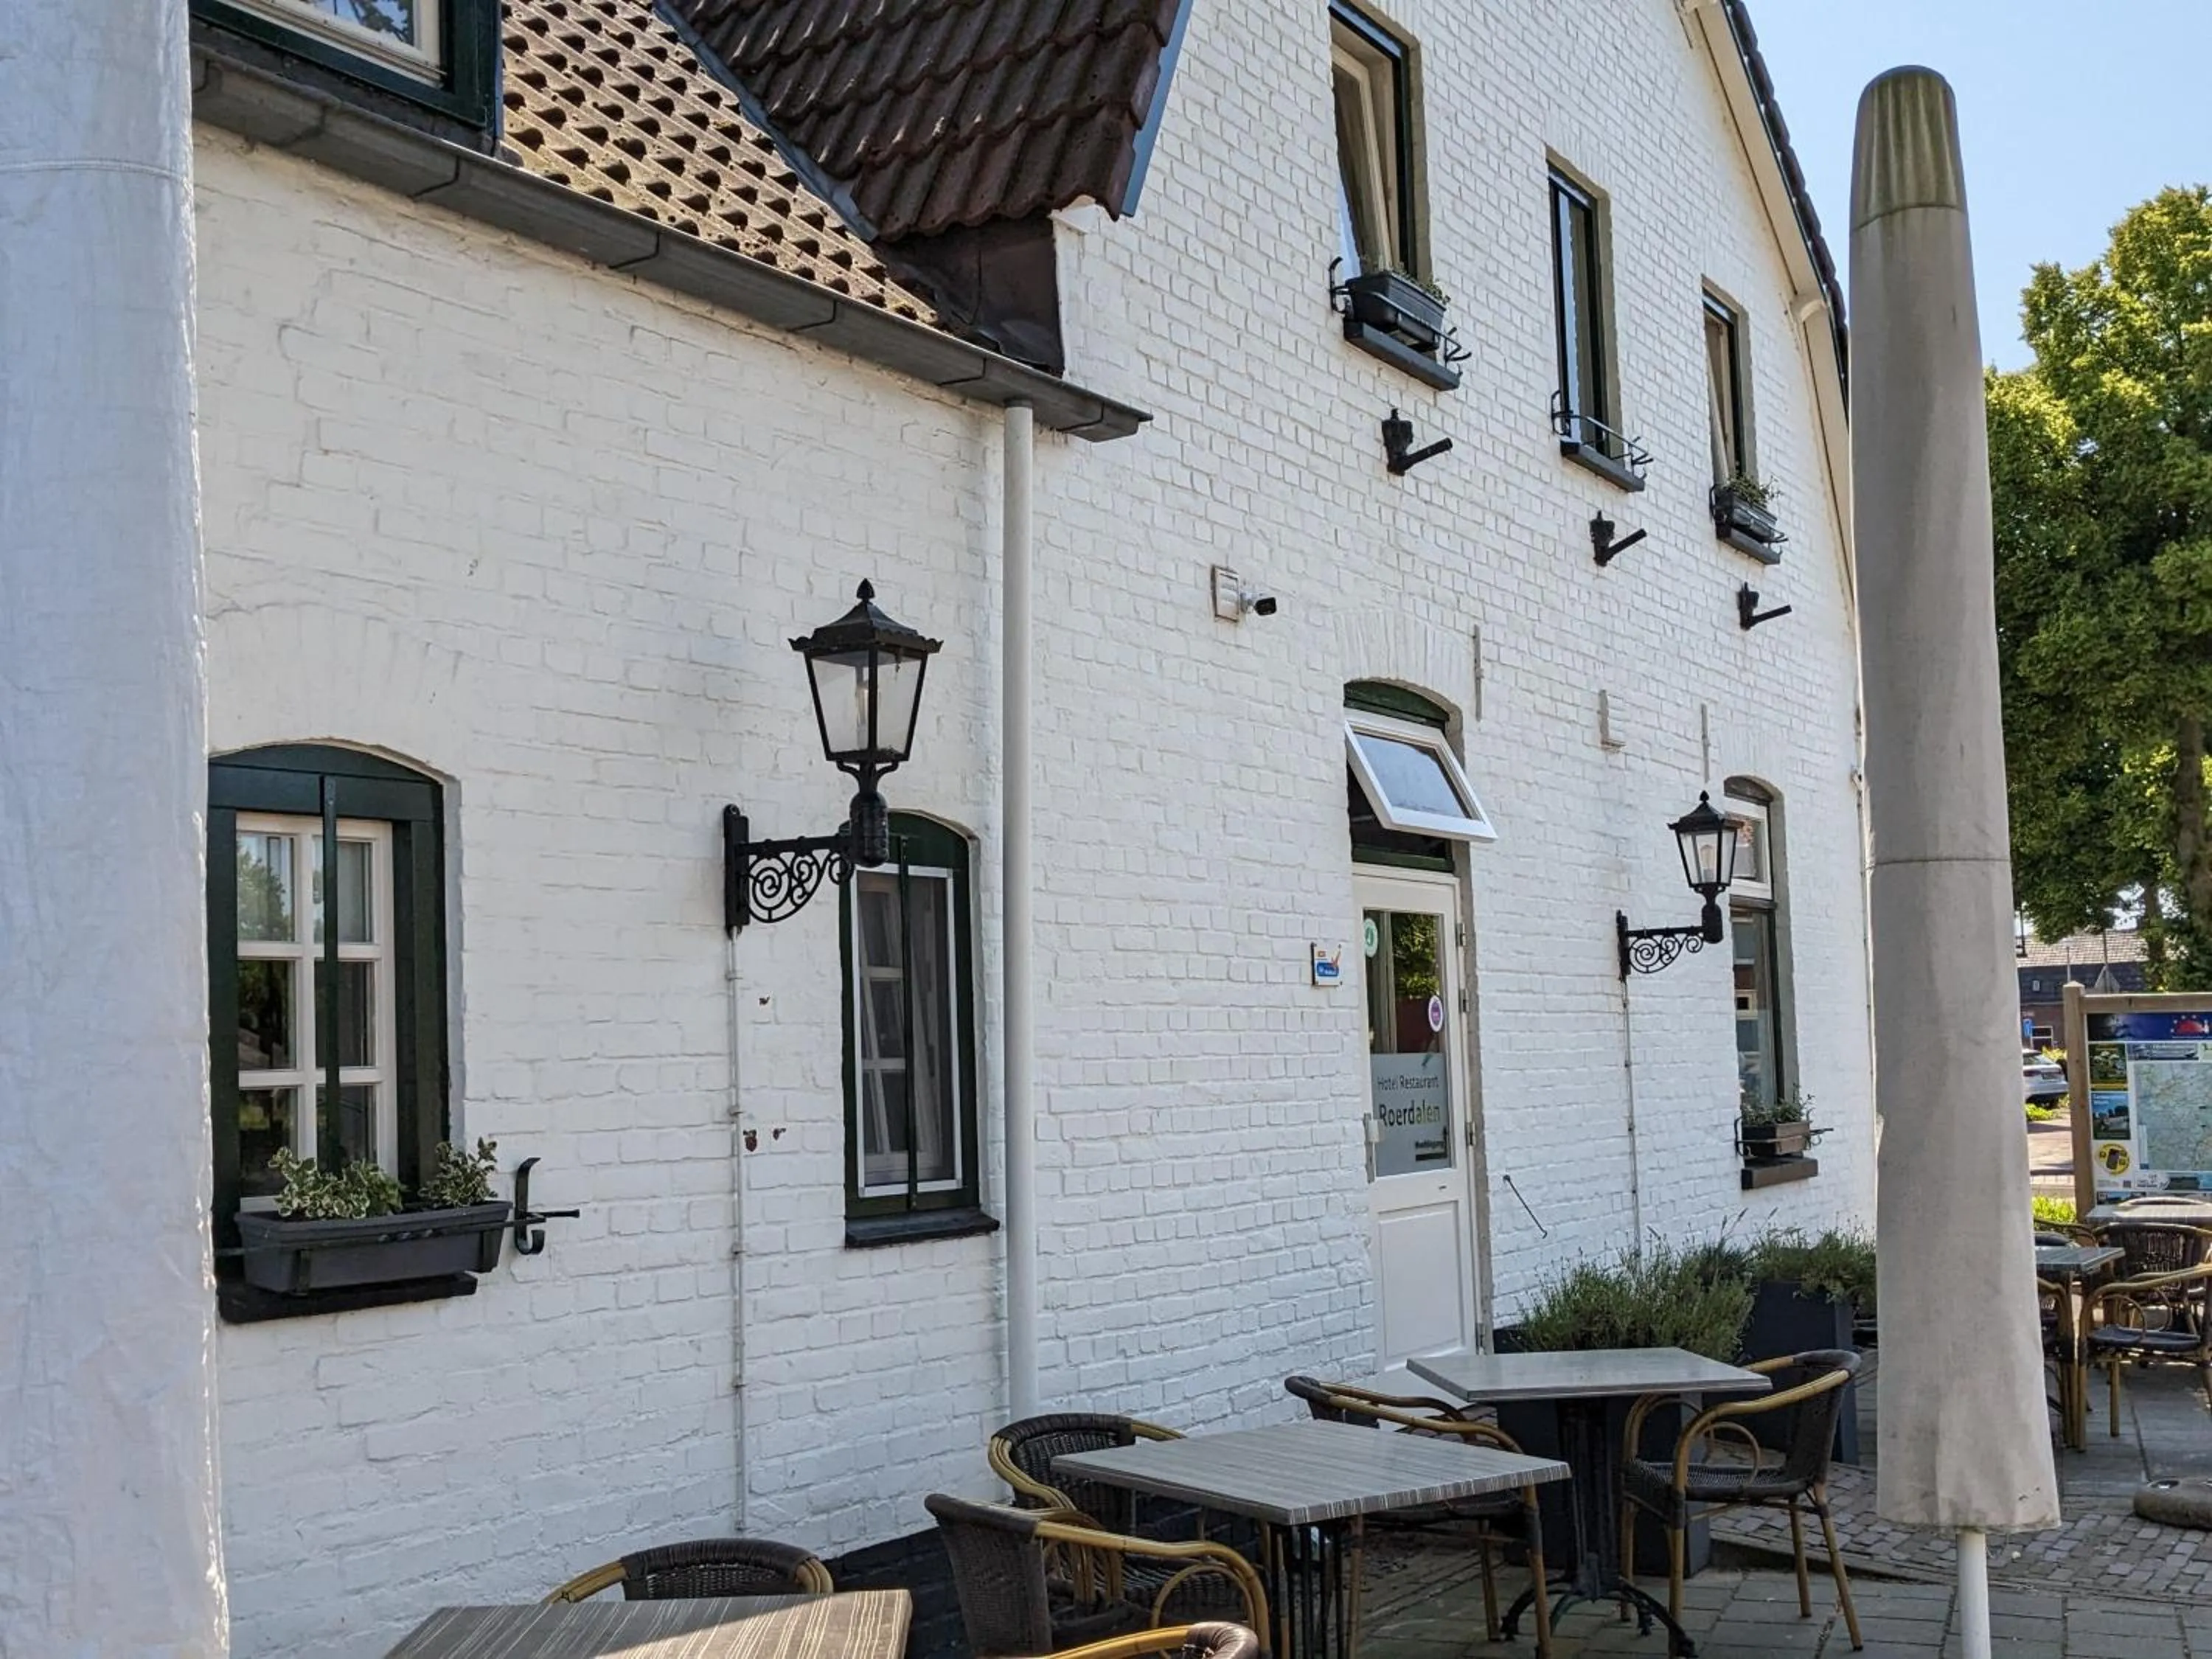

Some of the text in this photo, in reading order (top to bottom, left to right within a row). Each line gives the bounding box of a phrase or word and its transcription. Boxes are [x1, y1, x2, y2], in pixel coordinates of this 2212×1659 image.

[1377, 1074, 1439, 1091] Hotel Restaurant
[1379, 1099, 1440, 1127] Roerdalen
